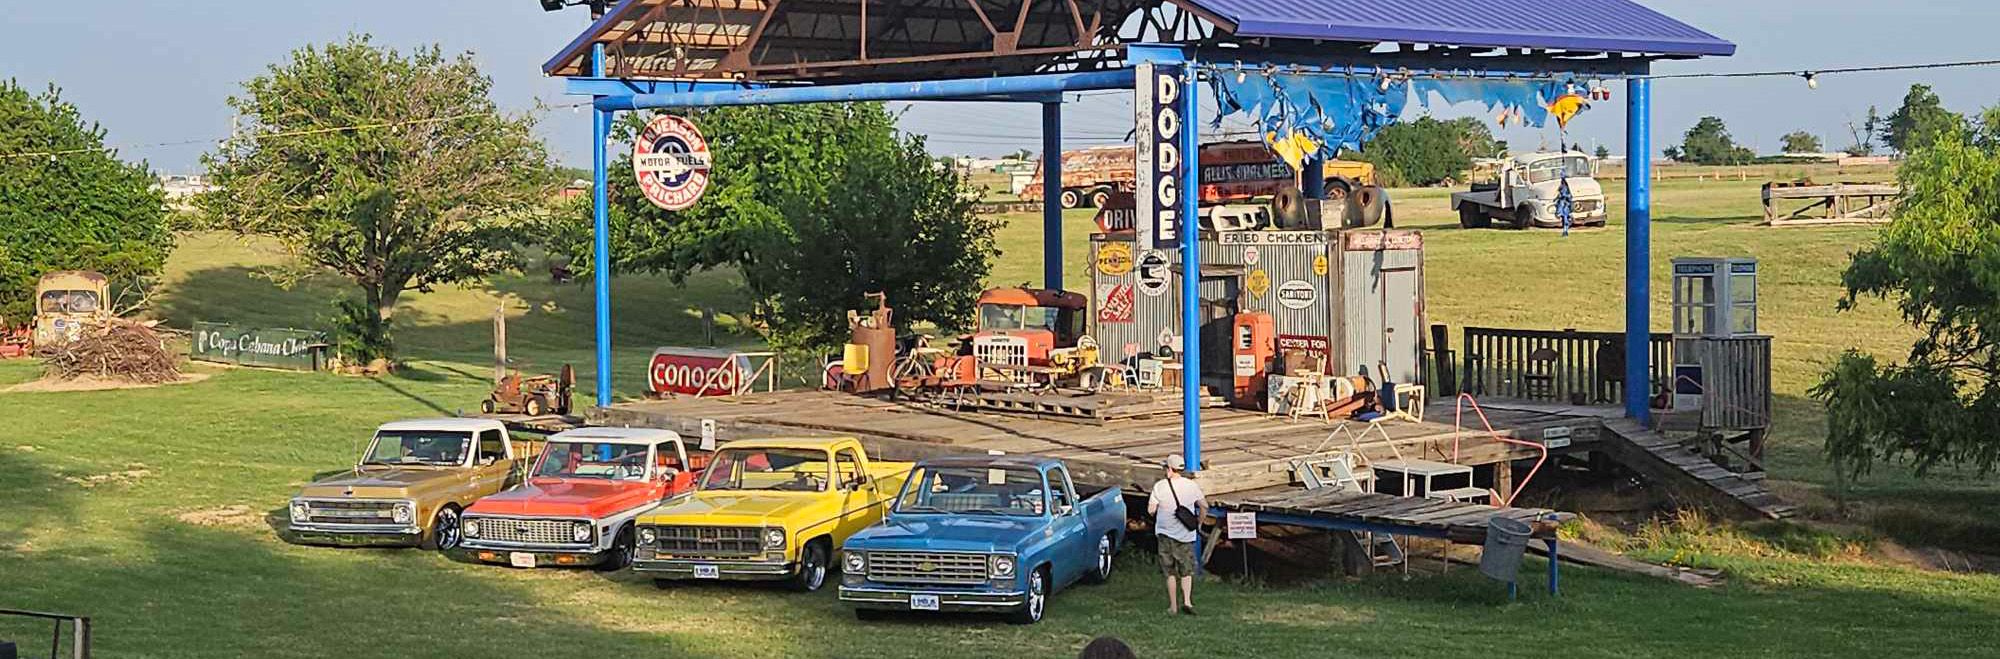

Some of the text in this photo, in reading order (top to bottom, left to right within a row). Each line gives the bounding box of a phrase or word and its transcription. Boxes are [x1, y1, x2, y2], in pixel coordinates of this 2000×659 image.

[640, 155, 704, 167] MOTOR FUELS
[1158, 74, 1179, 240] DODGE
[1224, 233, 1323, 243] FRIED CHICKEN
[1311, 339, 1327, 349] FOR
